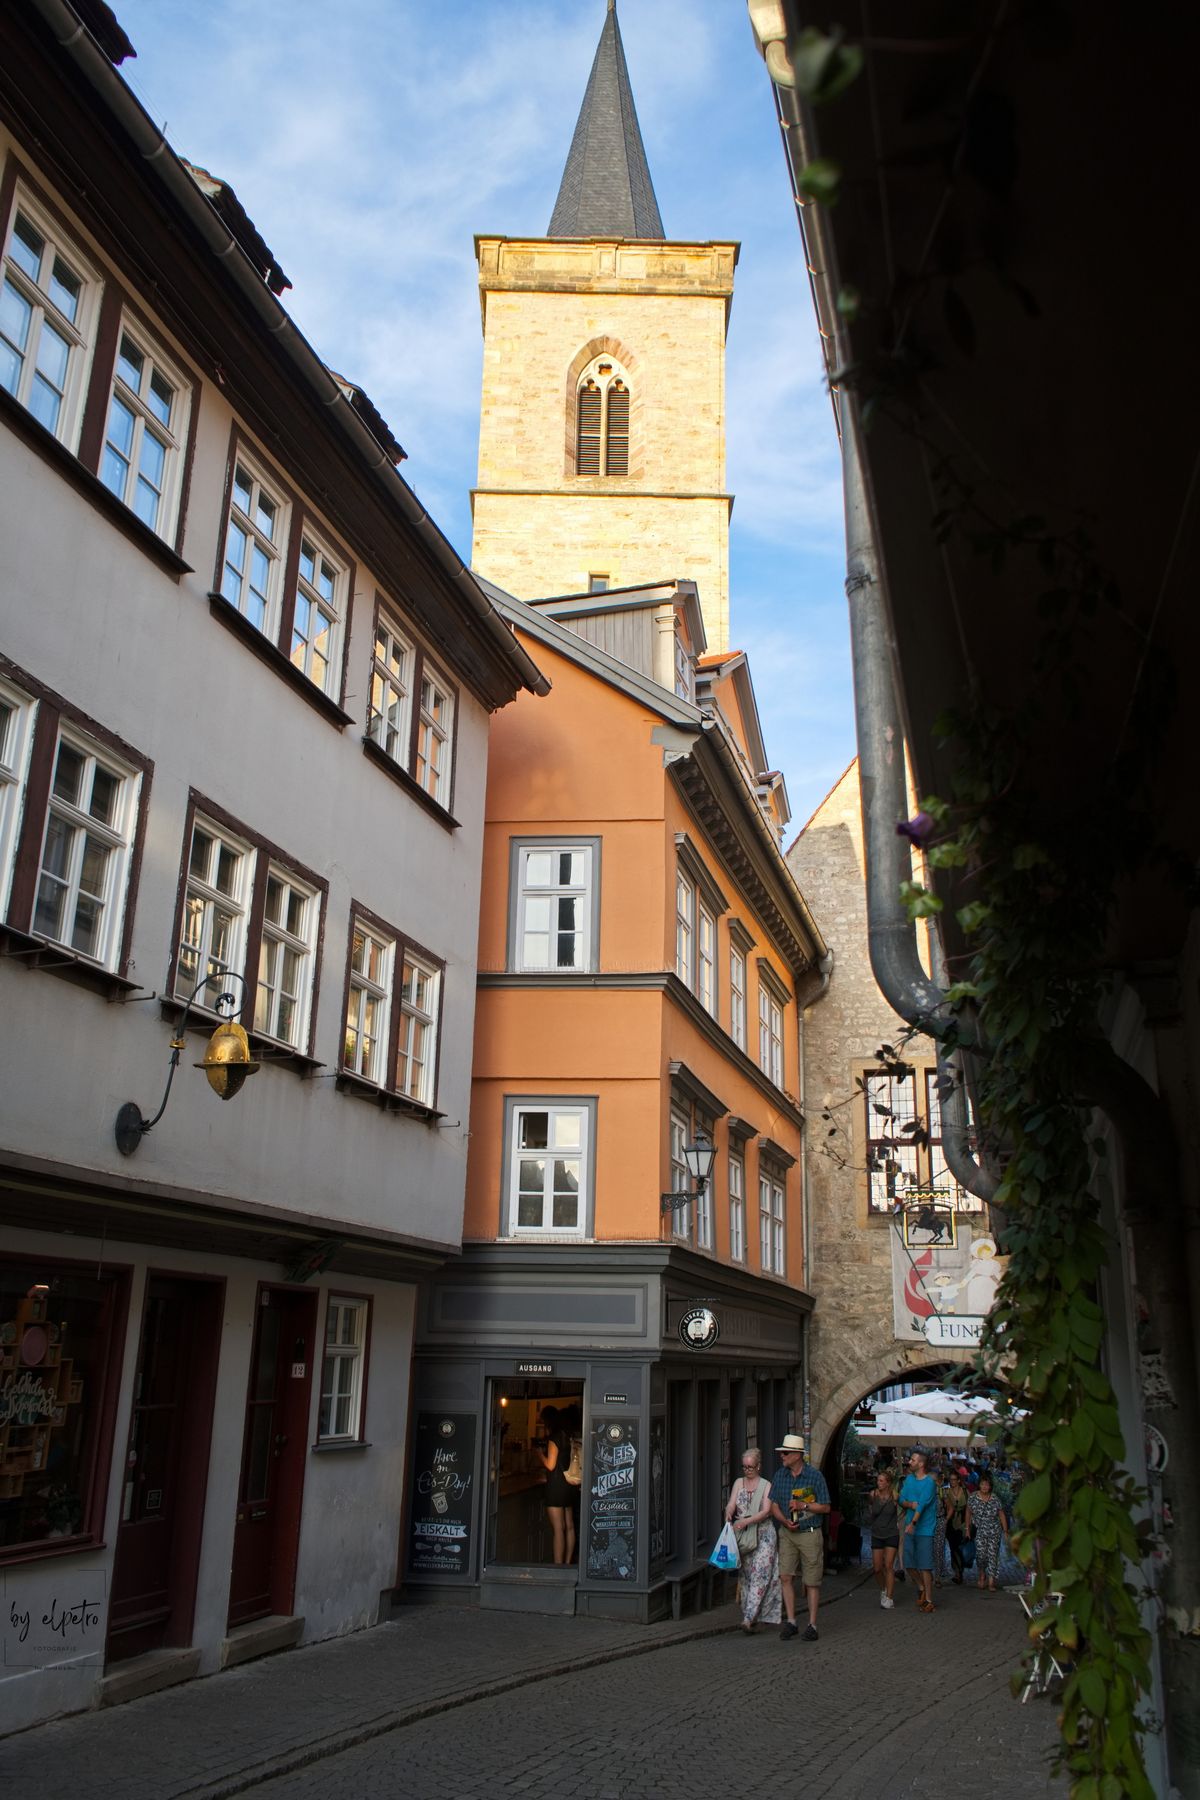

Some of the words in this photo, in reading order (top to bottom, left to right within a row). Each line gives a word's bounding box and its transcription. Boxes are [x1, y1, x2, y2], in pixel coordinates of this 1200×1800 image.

[519, 1364, 552, 1372] AUSGANG
[433, 1448, 458, 1464] Have
[615, 1446, 634, 1459] EIS
[436, 1464, 448, 1473] an
[599, 1468, 632, 1490] KIOSK
[600, 1501, 629, 1510] Eisdiele
[420, 1524, 460, 1536] EISKALT
